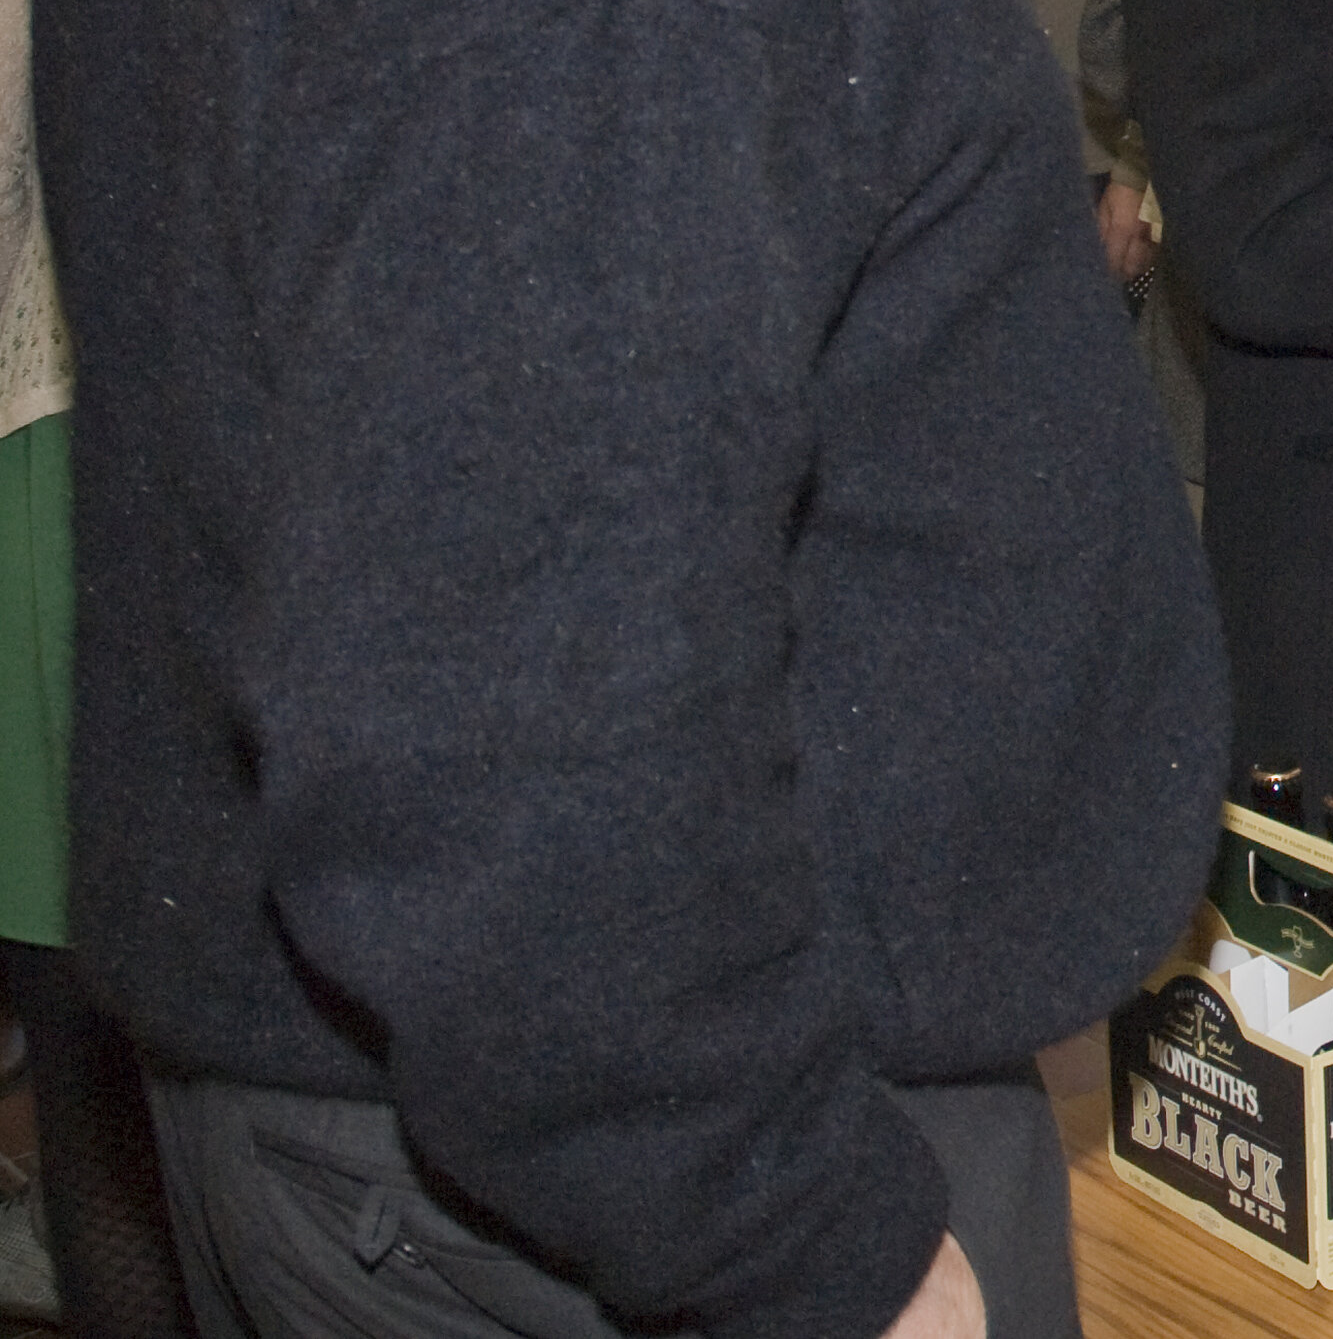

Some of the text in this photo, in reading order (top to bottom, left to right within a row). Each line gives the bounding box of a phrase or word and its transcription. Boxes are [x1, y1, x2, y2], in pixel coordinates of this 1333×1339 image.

[1149, 1035, 1260, 1118] MONTEITH'S
[1181, 1091, 1223, 1121] HEARTY
[1128, 1071, 1287, 1213] BLACK
[1228, 1189, 1287, 1235] BEER
